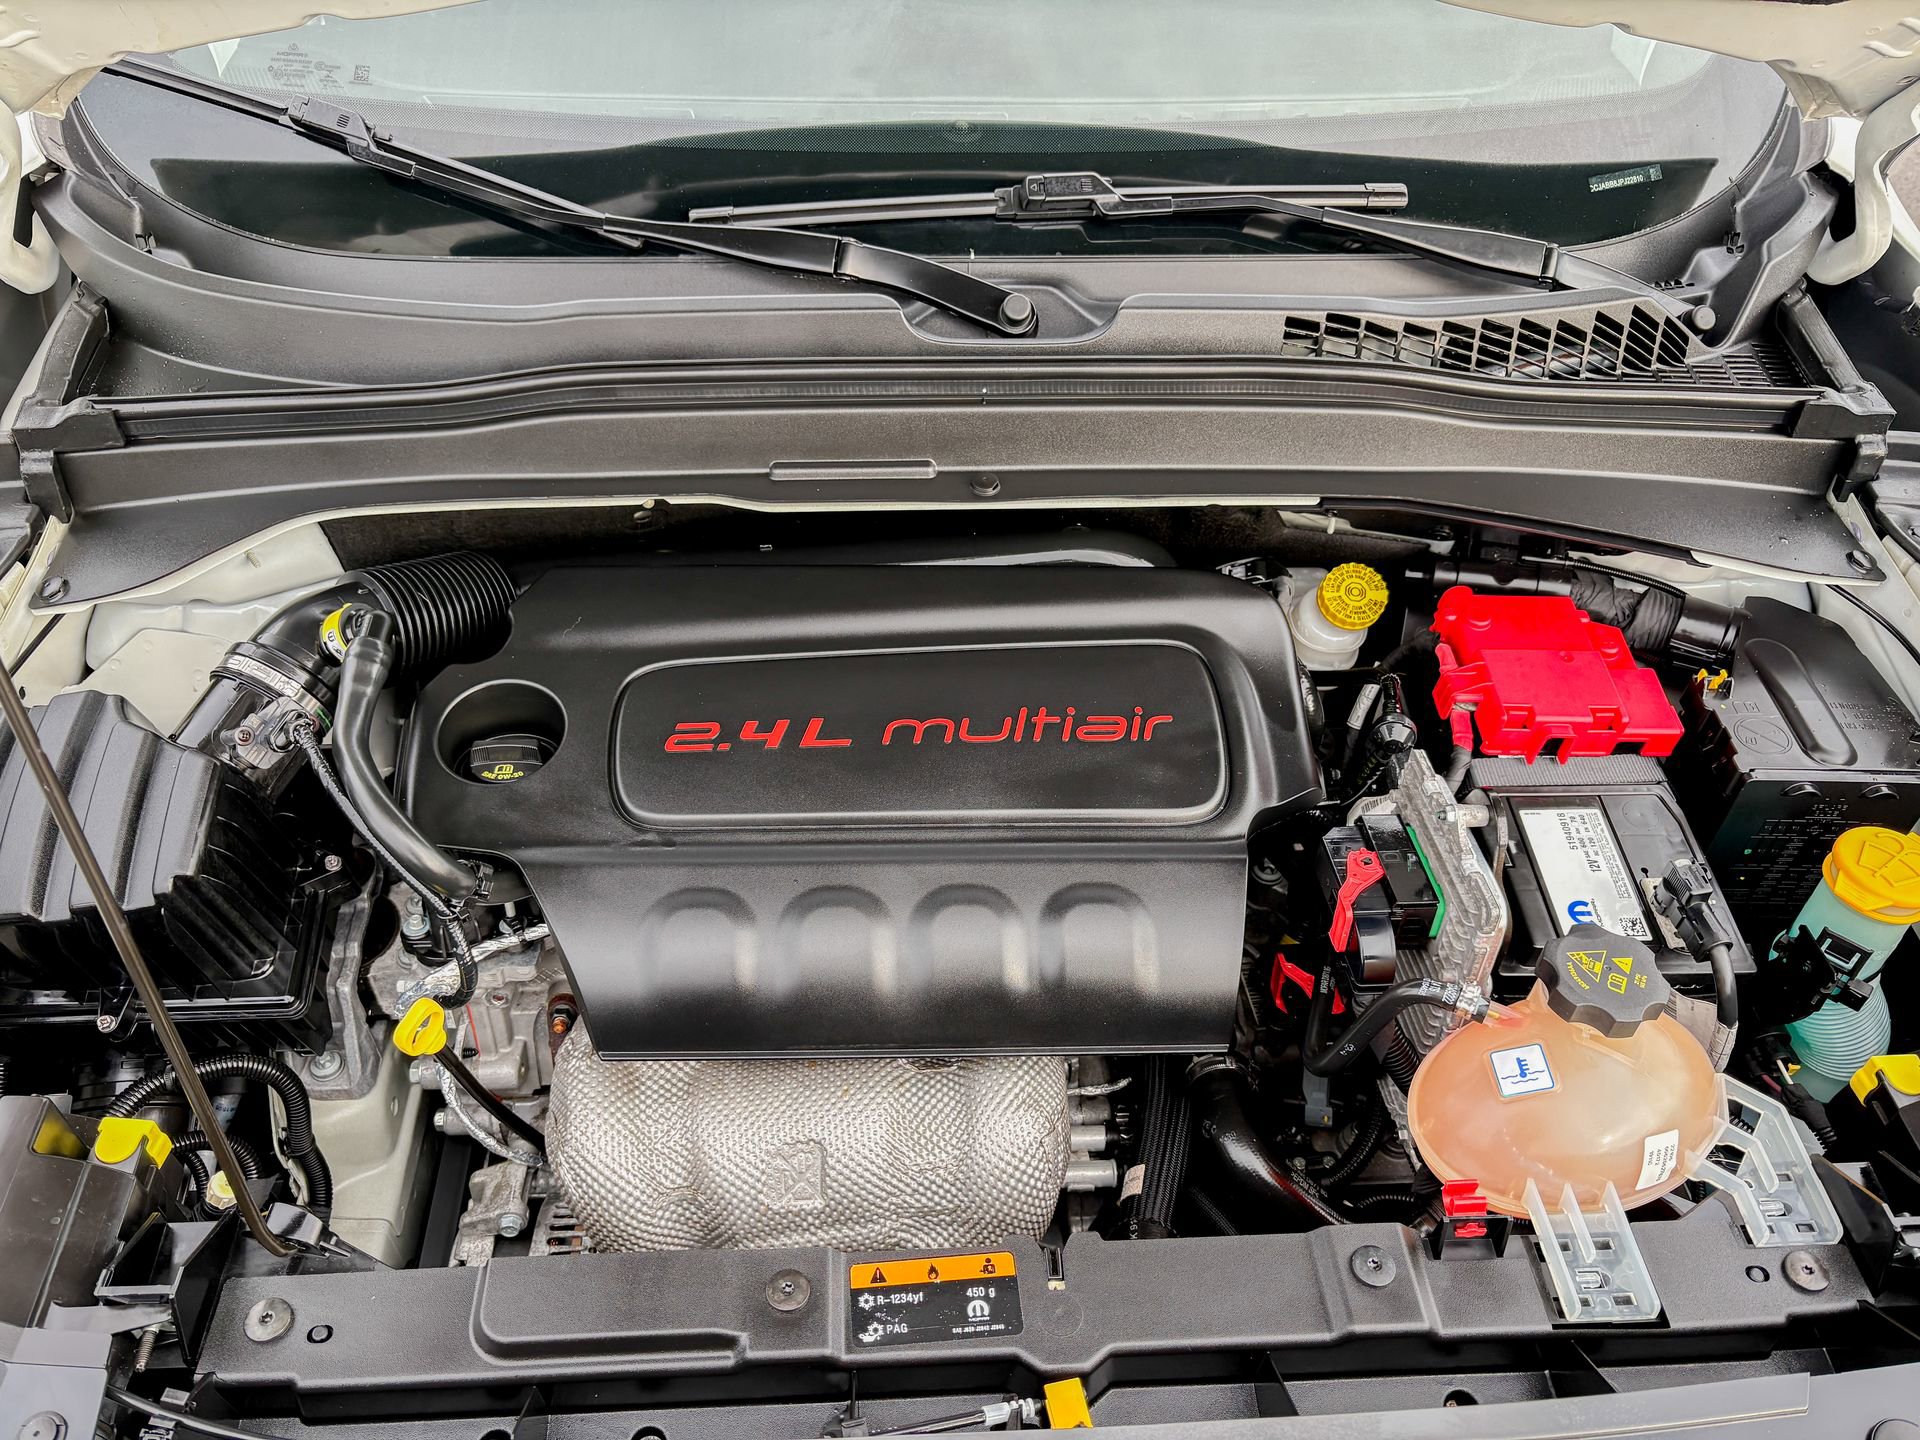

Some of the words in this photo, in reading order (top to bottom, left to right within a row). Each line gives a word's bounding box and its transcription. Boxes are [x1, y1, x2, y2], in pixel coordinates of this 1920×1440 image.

[882, 706, 1174, 745] multiair
[481, 771, 497, 780] SAE
[497, 771, 524, 780] 0W-20
[1556, 812, 1579, 850] 51940918
[1586, 859, 1602, 872] 12V
[966, 1286, 985, 1297] 450
[988, 1287, 995, 1298] g
[876, 1292, 923, 1306] R-1234yf
[886, 1324, 908, 1334] PAG
